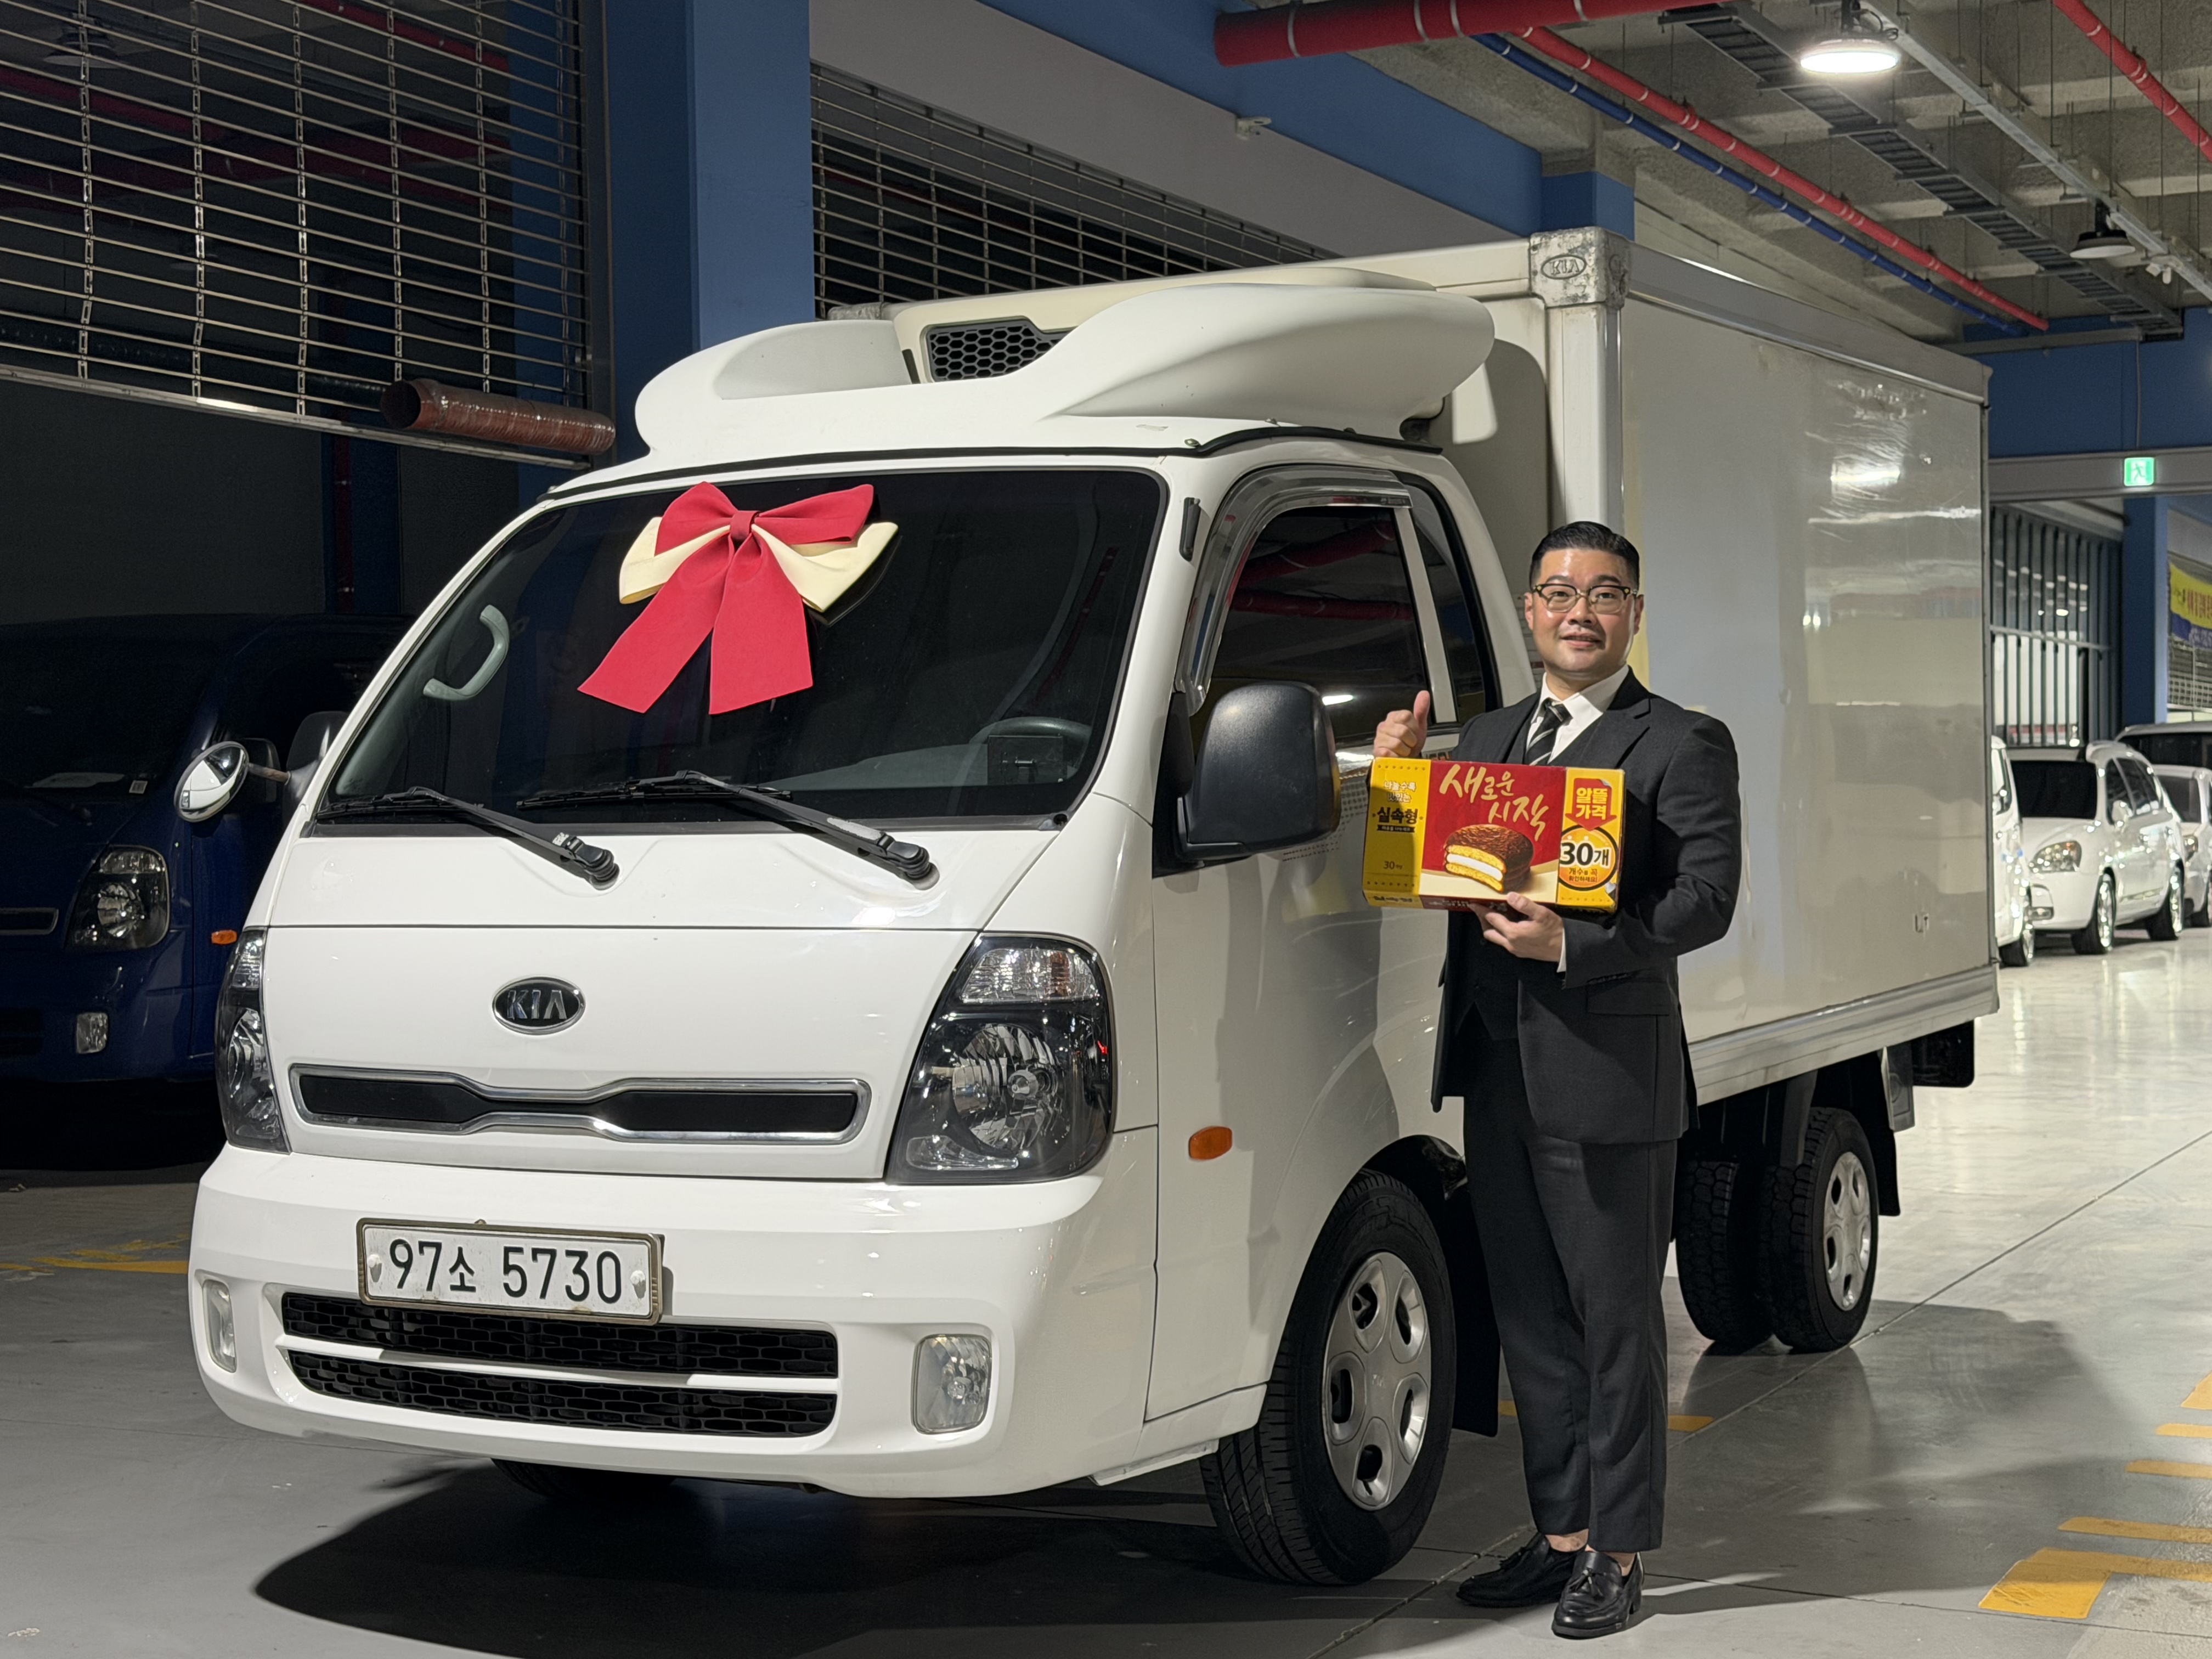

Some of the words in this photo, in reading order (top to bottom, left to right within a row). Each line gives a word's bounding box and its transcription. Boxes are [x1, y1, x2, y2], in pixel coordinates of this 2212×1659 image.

[1550, 259, 1581, 275] KIA
[1440, 764, 1515, 804] 새로운
[1576, 787, 1608, 804] 알뜰
[1377, 807, 1418, 825] 실속형
[1488, 793, 1549, 842] 시작
[1576, 804, 1607, 820] 가격
[1559, 842, 1610, 866] 30개
[507, 990, 567, 1020] KIA
[389, 1238, 476, 1293] 97소
[503, 1245, 622, 1304] 5730
